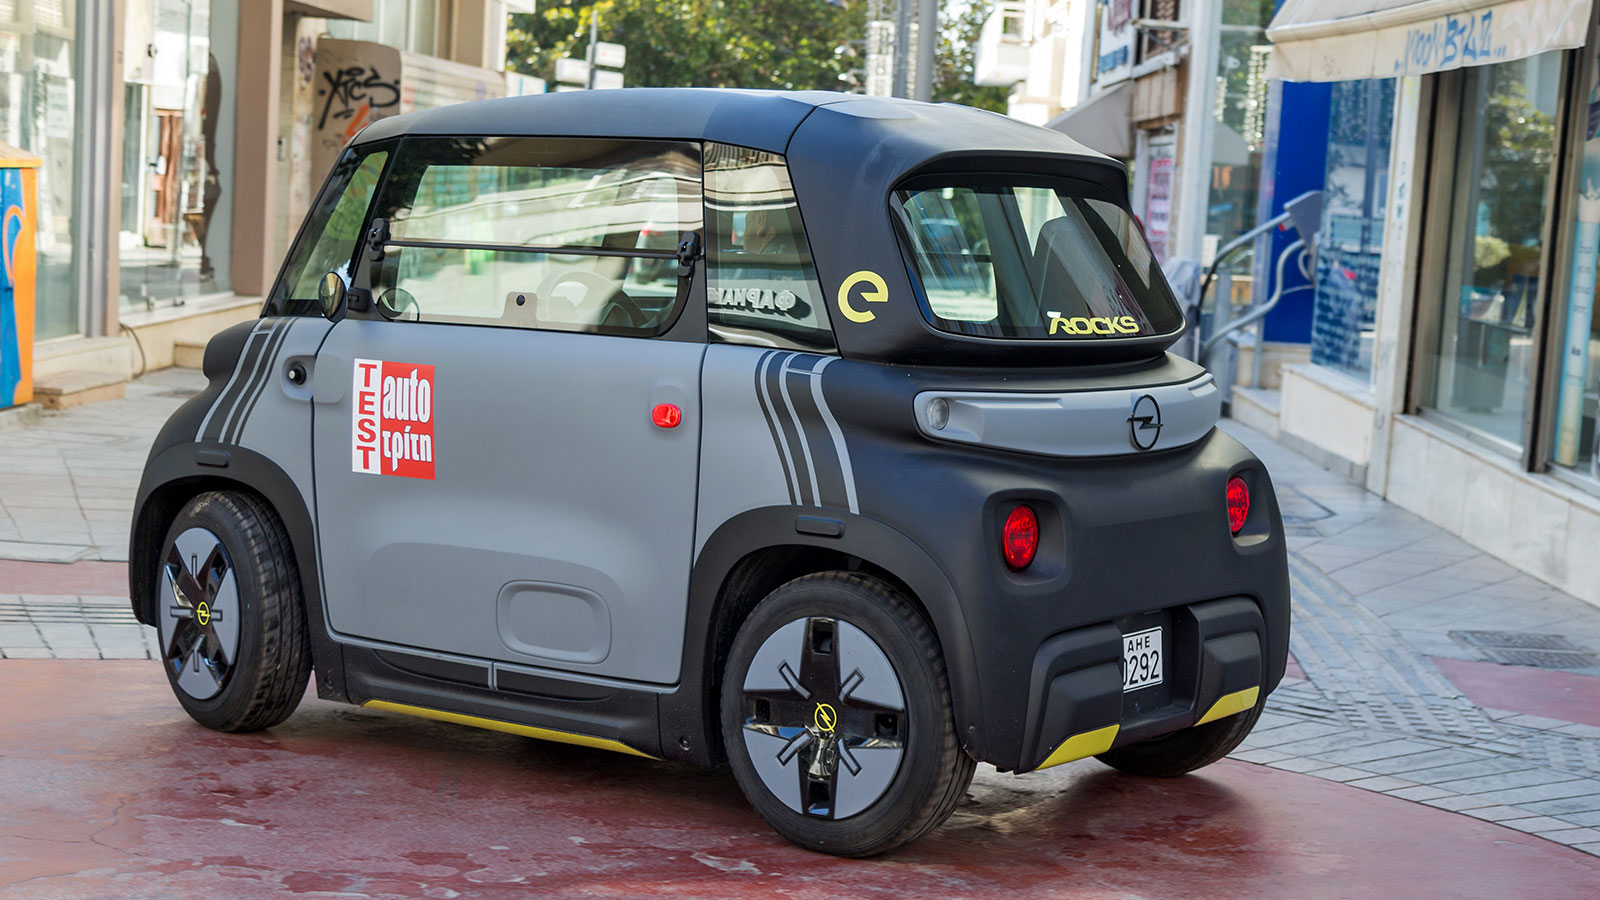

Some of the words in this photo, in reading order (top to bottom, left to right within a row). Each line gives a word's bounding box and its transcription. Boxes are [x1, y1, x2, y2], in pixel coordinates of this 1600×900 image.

[837, 270, 889, 323] e
[356, 363, 378, 470] TEST
[382, 367, 431, 423] auto
[382, 425, 432, 472] τρίτη
